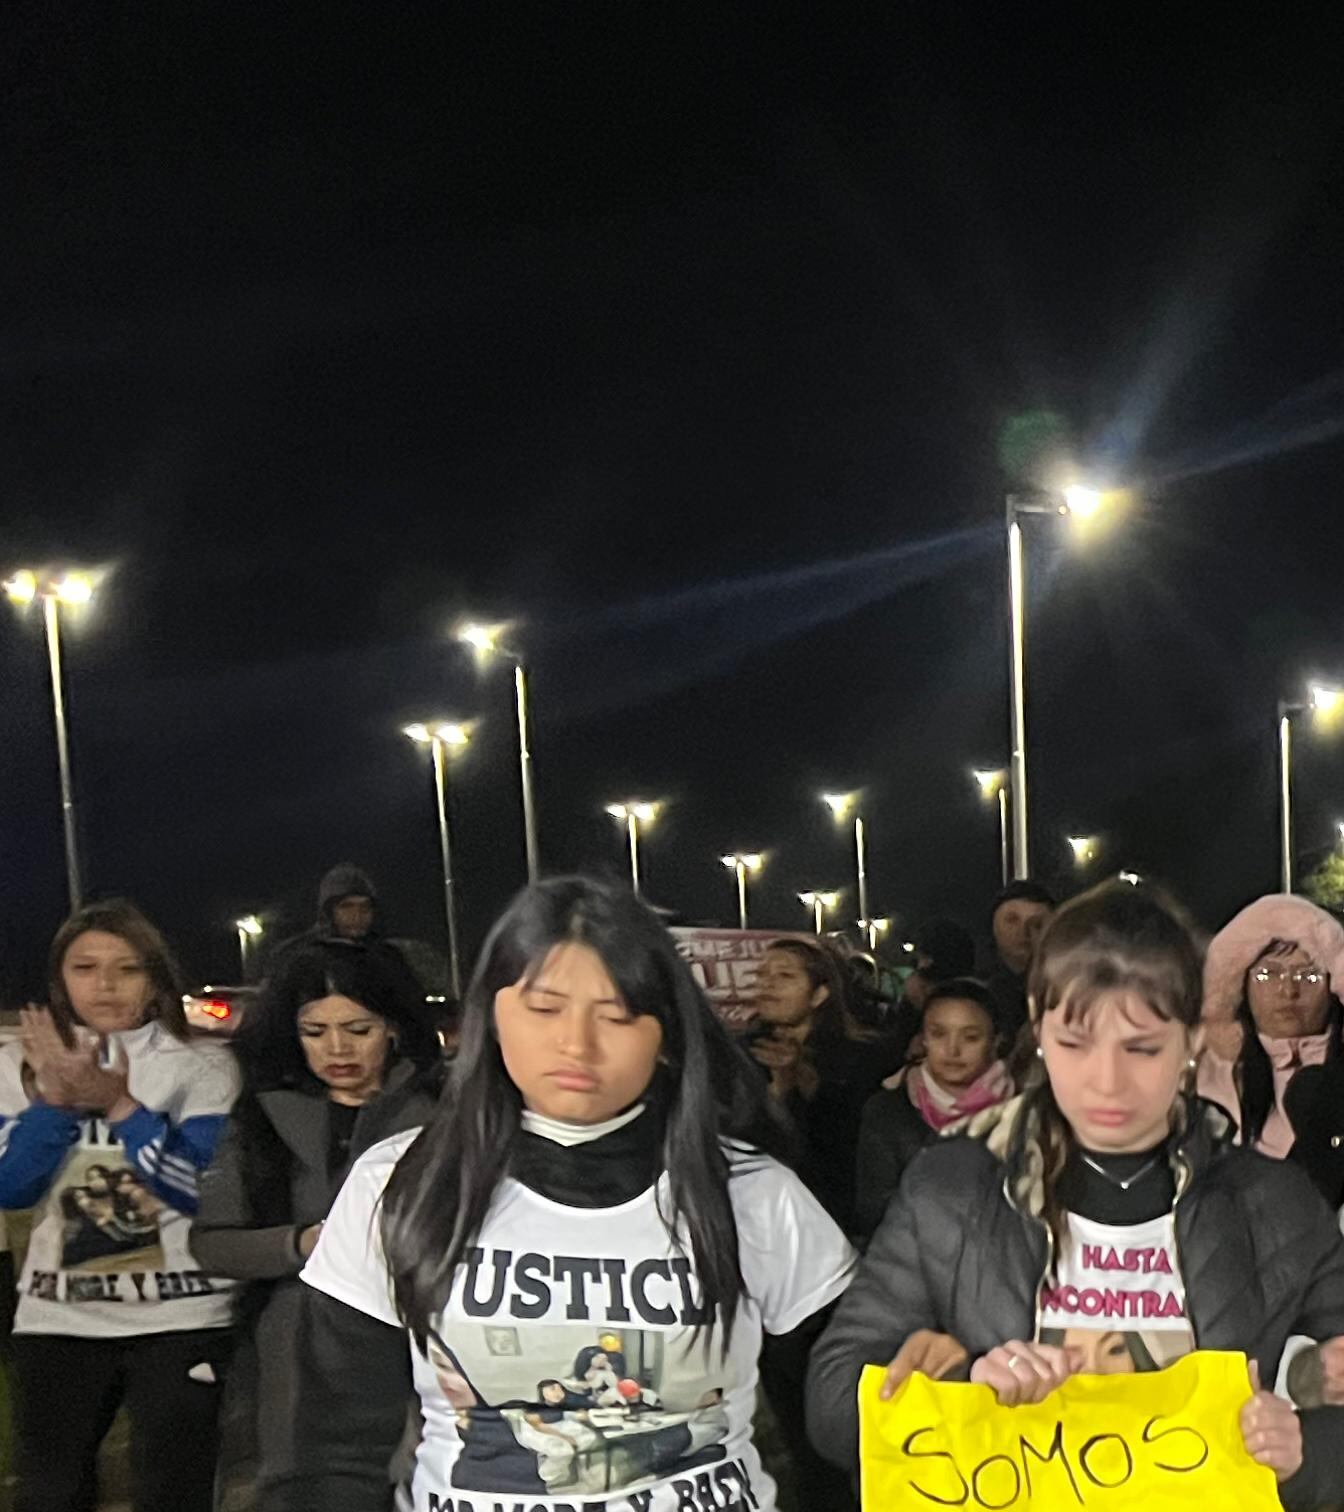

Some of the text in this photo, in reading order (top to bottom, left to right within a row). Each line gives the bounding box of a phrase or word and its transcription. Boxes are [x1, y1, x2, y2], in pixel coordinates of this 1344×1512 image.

[1082, 1243, 1173, 1274] HASTA
[1040, 1285, 1185, 1318] NCONTRA
[902, 1415, 1208, 1510] SOMOS
